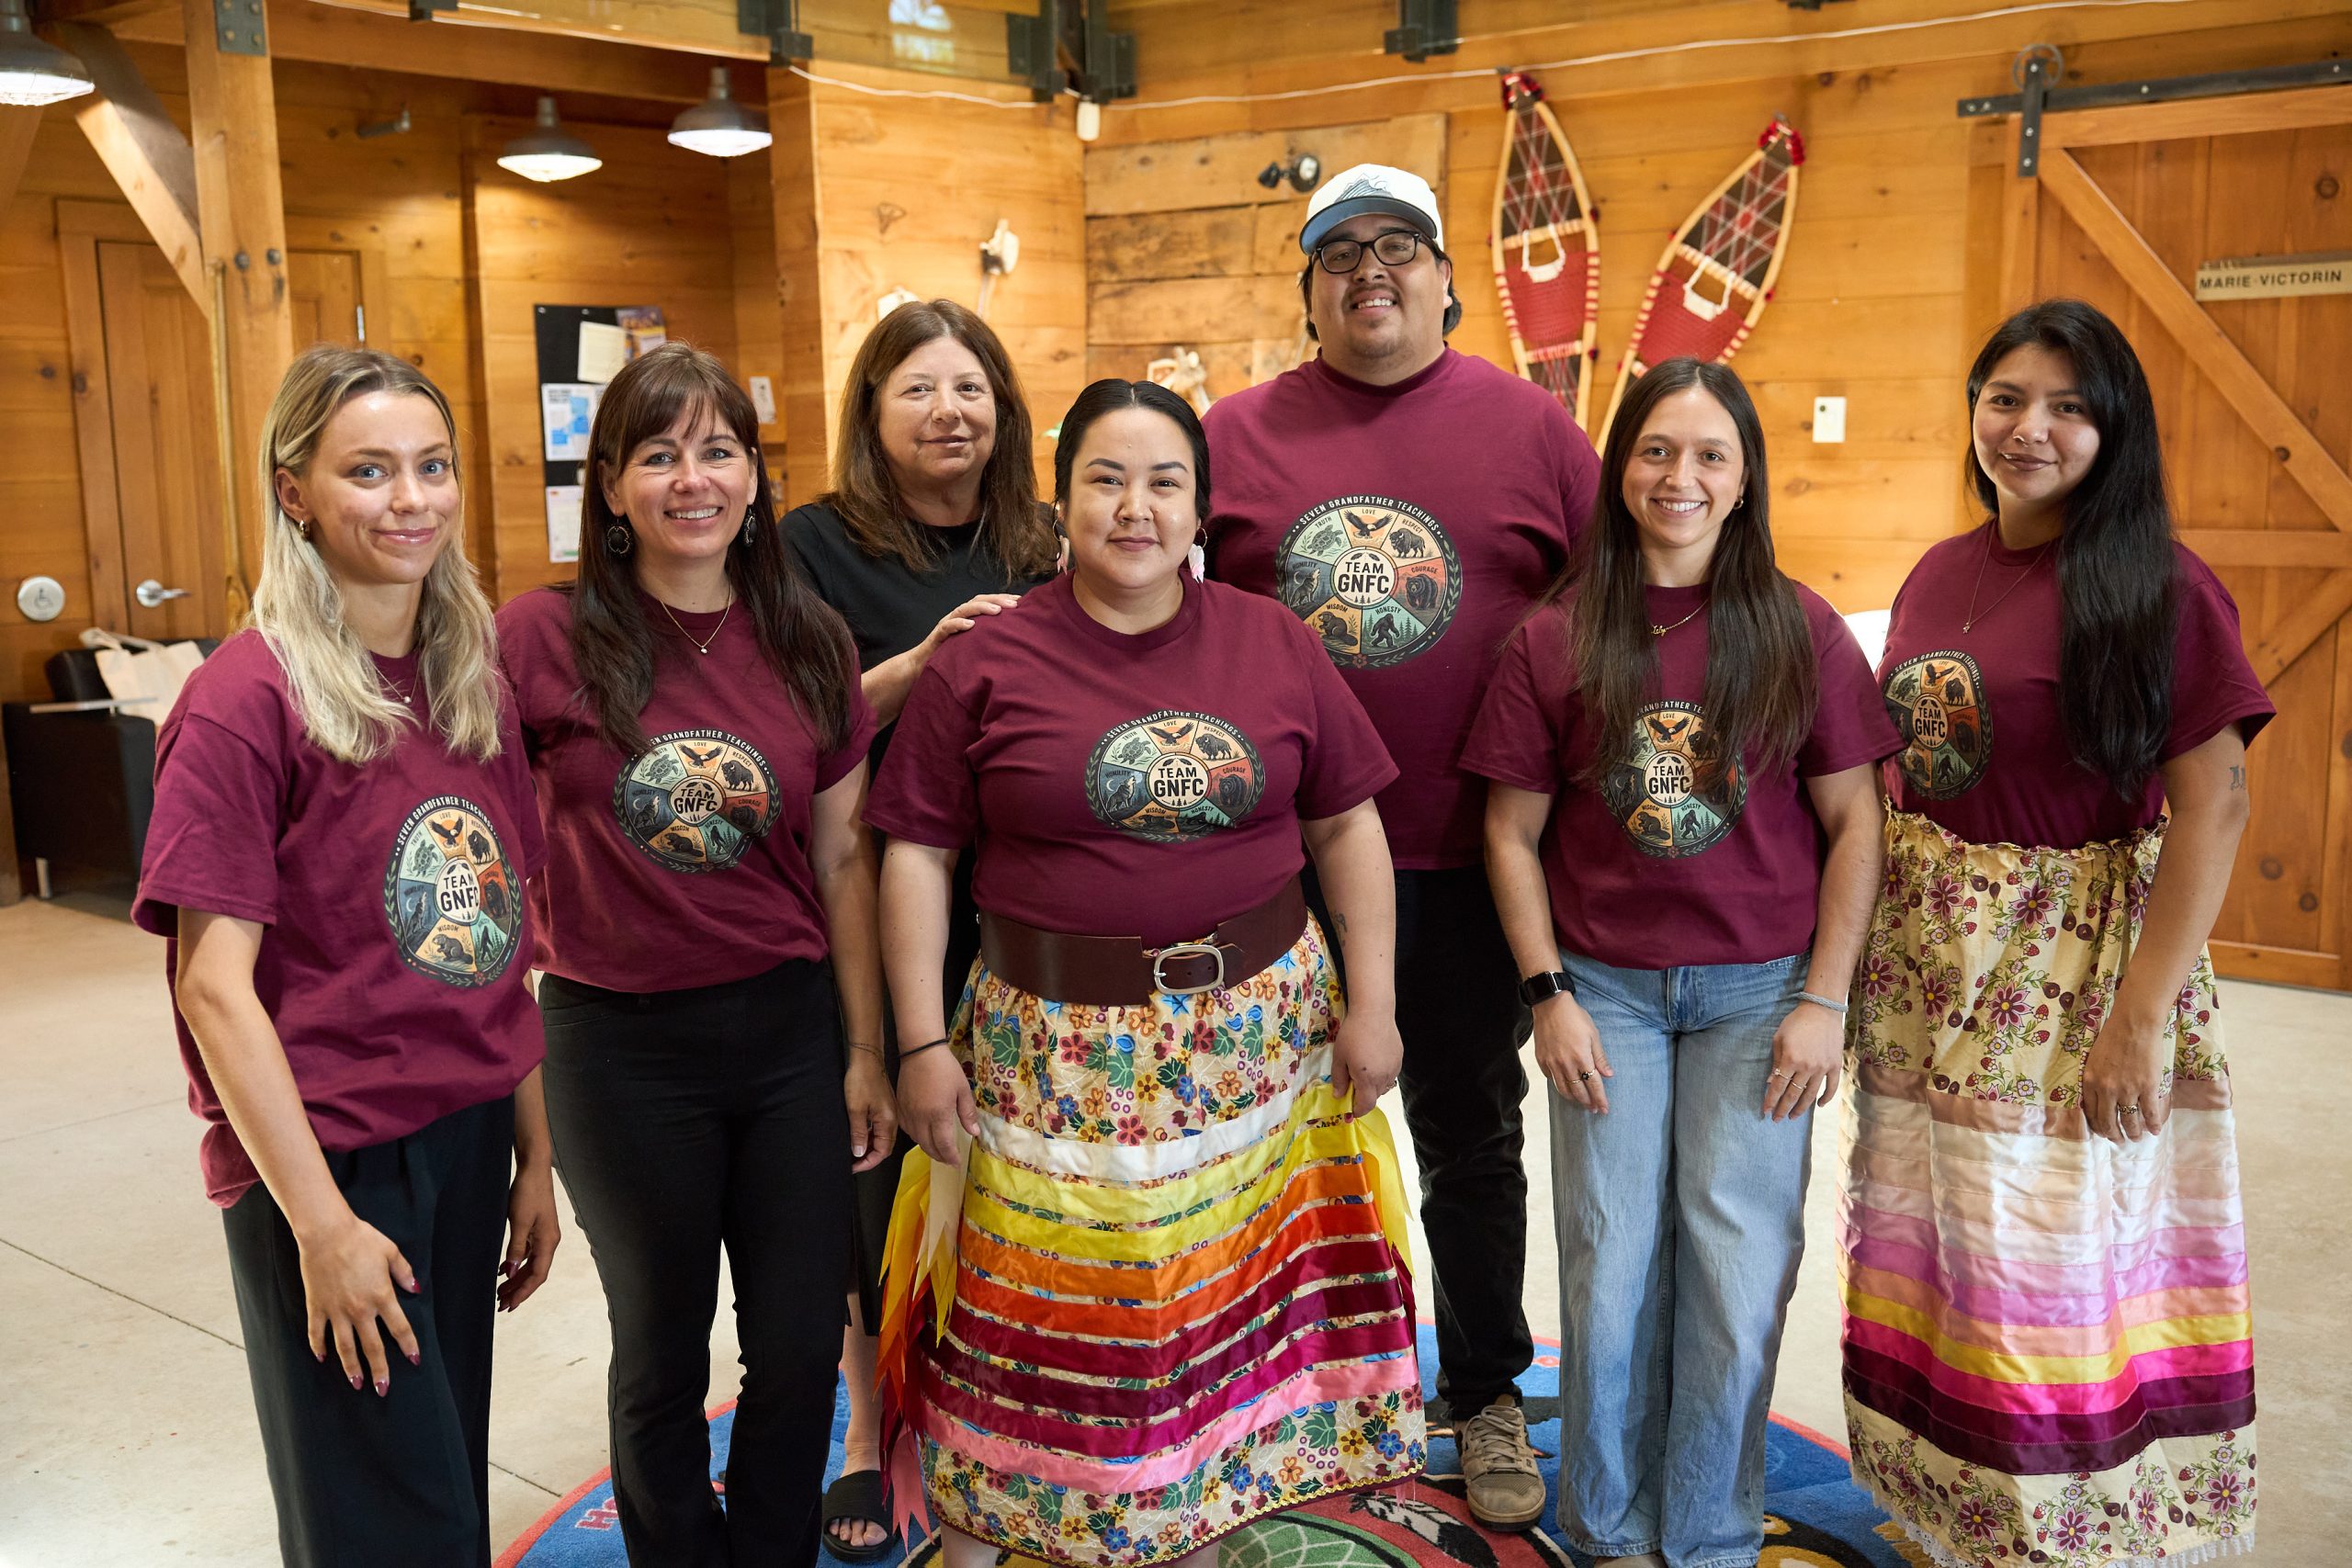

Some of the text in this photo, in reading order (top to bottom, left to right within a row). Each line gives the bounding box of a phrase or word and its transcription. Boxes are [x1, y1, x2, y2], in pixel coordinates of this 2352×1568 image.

[2199, 270, 2342, 289] MARIE VICTORIN
[1299, 496, 1439, 531] SEVEN GRANDFATHER TEACHINGS
[1314, 516, 1332, 529] TRUTH
[1402, 519, 1423, 534] RESPECT
[1345, 561, 1384, 574] TEAM
[1410, 566, 1439, 574] COURAGE
[1338, 573, 1389, 594] GNFC
[1326, 604, 1349, 613] WISDOM
[1894, 657, 1918, 673] SEVEN
[1920, 650, 1965, 660] GRANDFATHER
[1637, 701, 1690, 716] RANDFATHER
[1918, 707, 1940, 720] TEAM
[1106, 709, 1238, 739] SEVEN GRANDFATHER TEACHINGS
[1915, 717, 1945, 739] GNFC
[1122, 731, 1137, 740] TRUTH
[1204, 726, 1226, 738] RESPECT
[662, 729, 766, 766] GRANDFATHER TEACHINGS
[732, 751, 752, 767] RESPECT
[1158, 767, 1197, 778] TEAM
[1653, 765, 1685, 776] TEAM
[1154, 778, 1204, 797] GNFC
[1648, 776, 1690, 795] GNFC
[681, 788, 715, 800] TEAM
[673, 796, 718, 814] GNFC
[397, 818, 415, 845] SEVEN
[413, 796, 459, 820] GRANDFATHER
